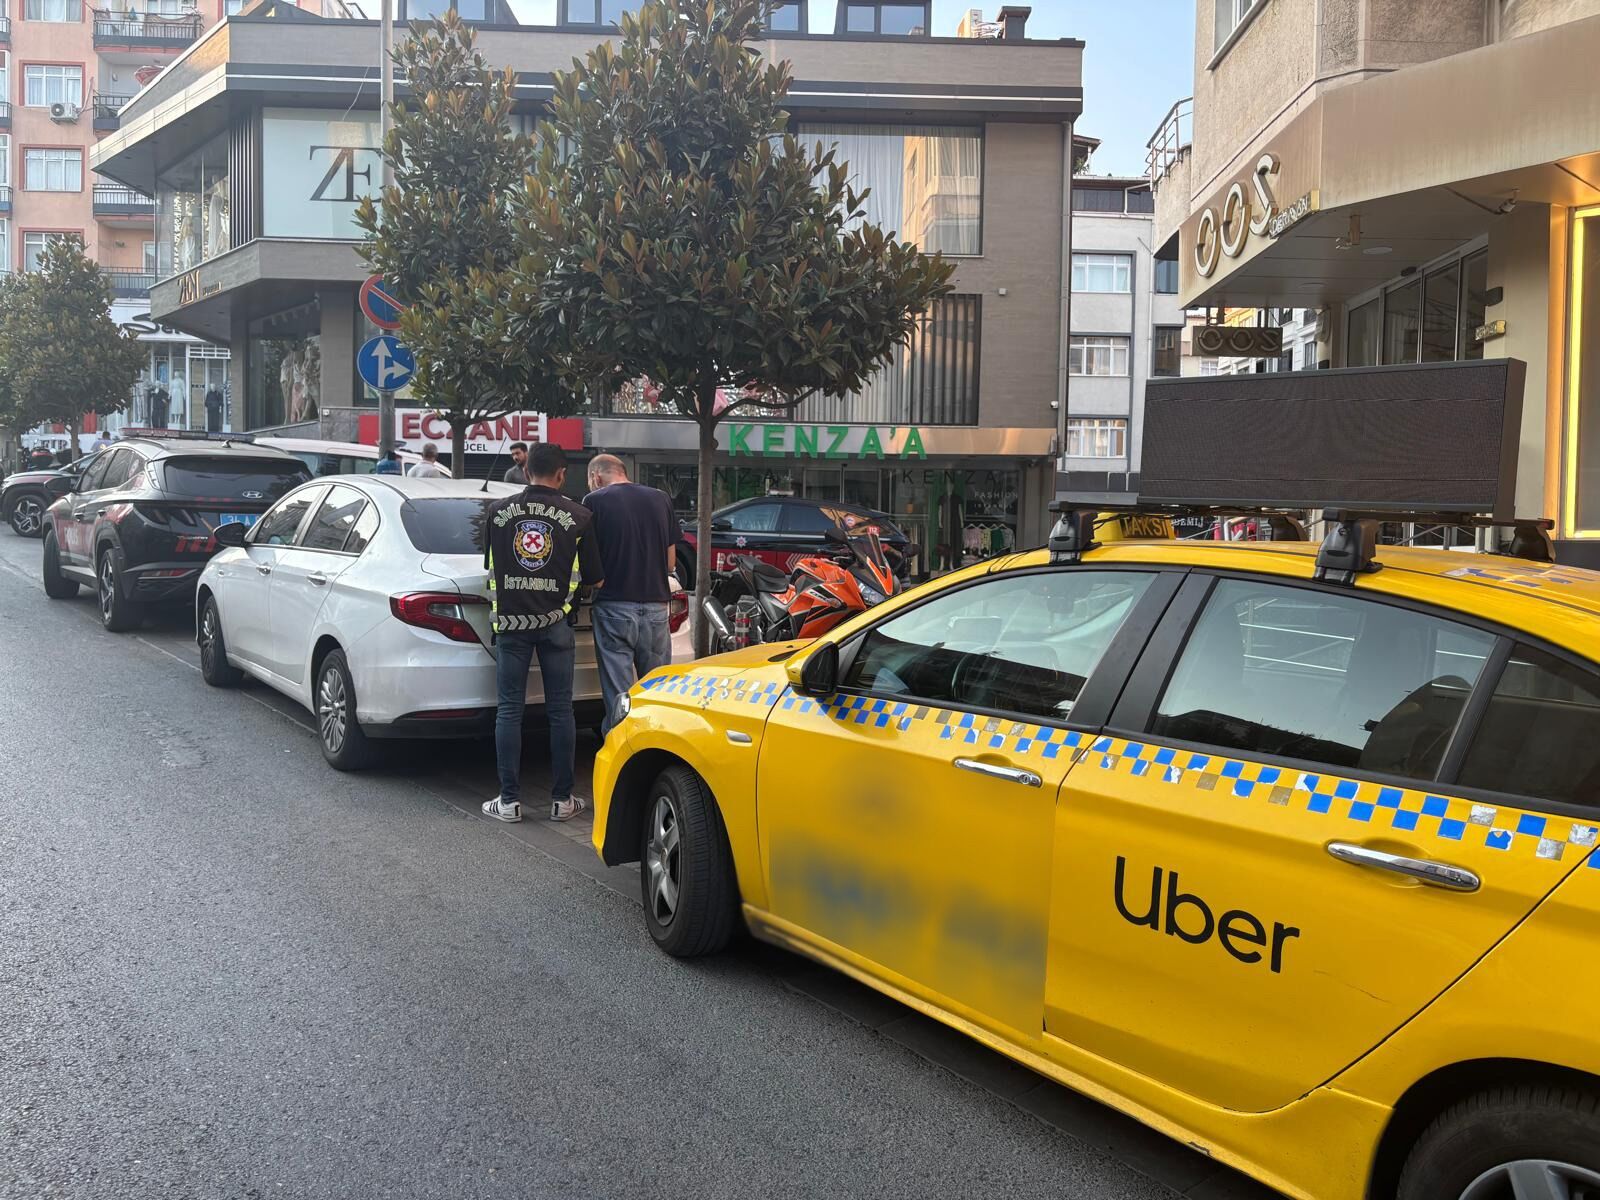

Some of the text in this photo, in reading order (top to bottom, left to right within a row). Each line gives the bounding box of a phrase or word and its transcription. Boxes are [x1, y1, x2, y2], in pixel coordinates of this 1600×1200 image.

[402, 413, 540, 441] ECANE
[463, 441, 488, 452] ÜCEL
[728, 424, 928, 460] KENZA'A
[493, 502, 577, 531] SİVİL TRAFİK
[504, 574, 559, 592] İSTANBUL
[1114, 855, 1300, 973] Uber
